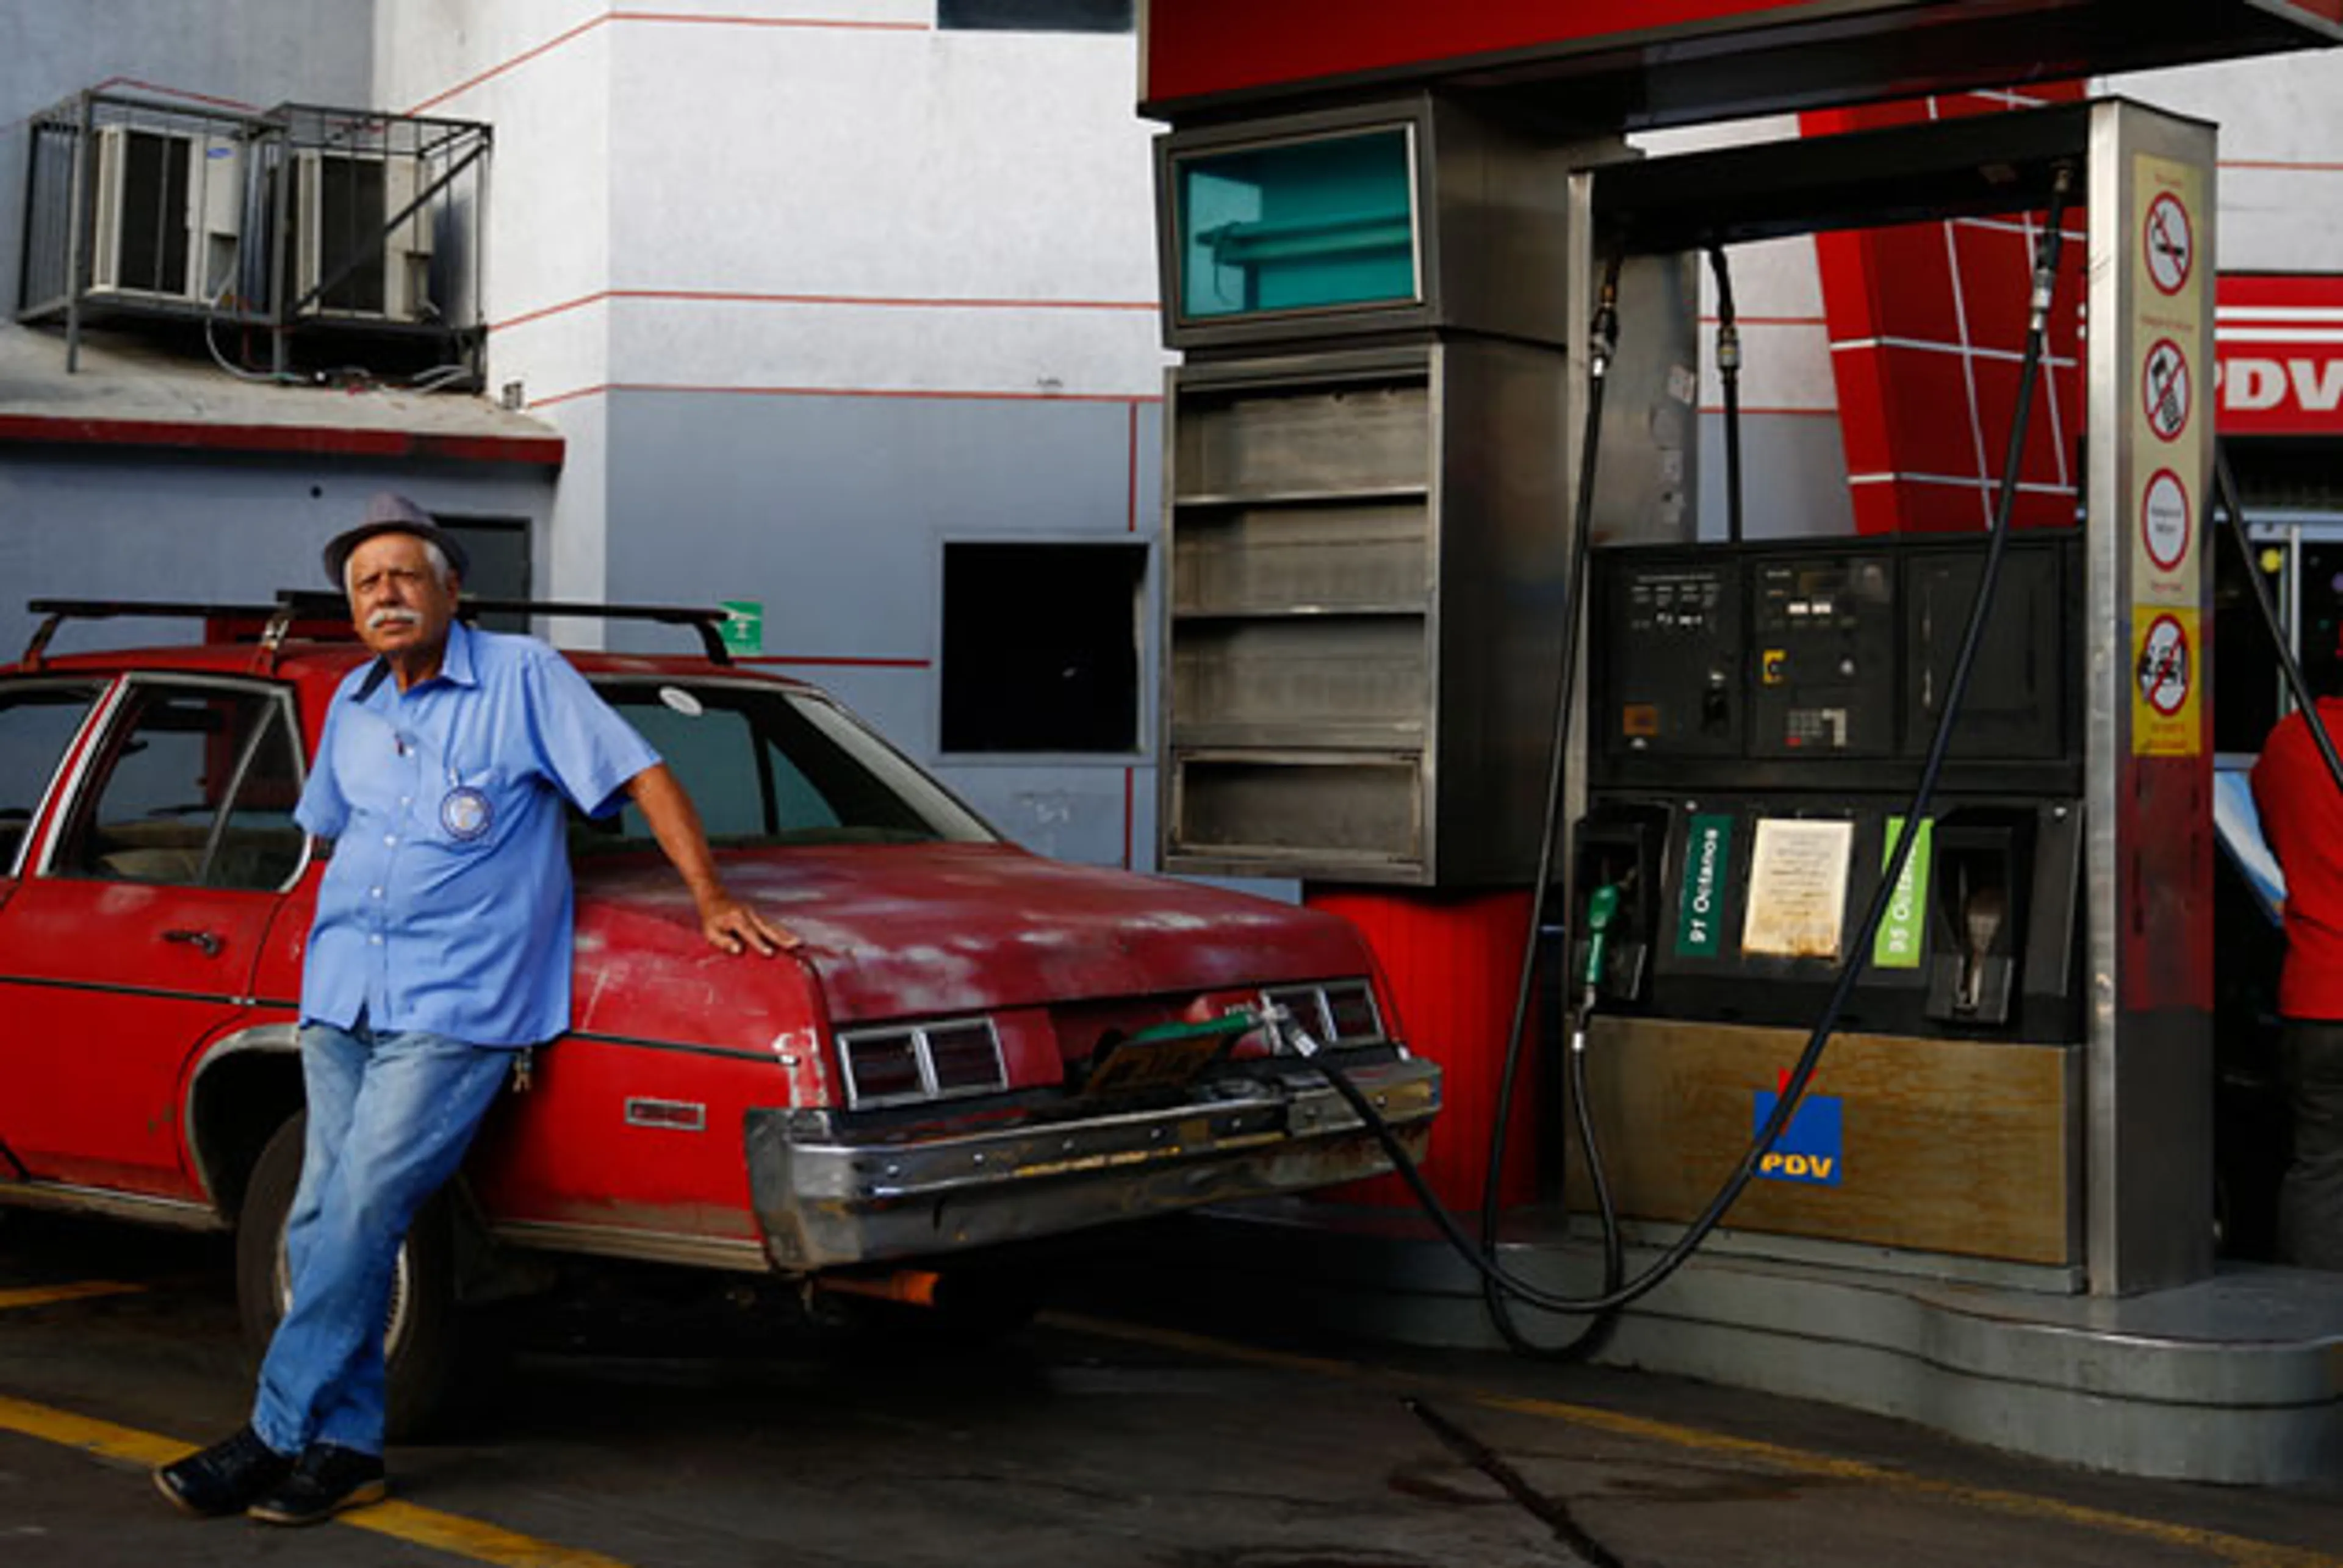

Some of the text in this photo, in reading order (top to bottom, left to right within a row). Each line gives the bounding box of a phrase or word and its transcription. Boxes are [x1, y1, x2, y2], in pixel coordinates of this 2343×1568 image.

[2214, 358, 2343, 410] DV
[1689, 828, 1719, 943] 91 Octanos
[1760, 1152, 1833, 1179] PDV
